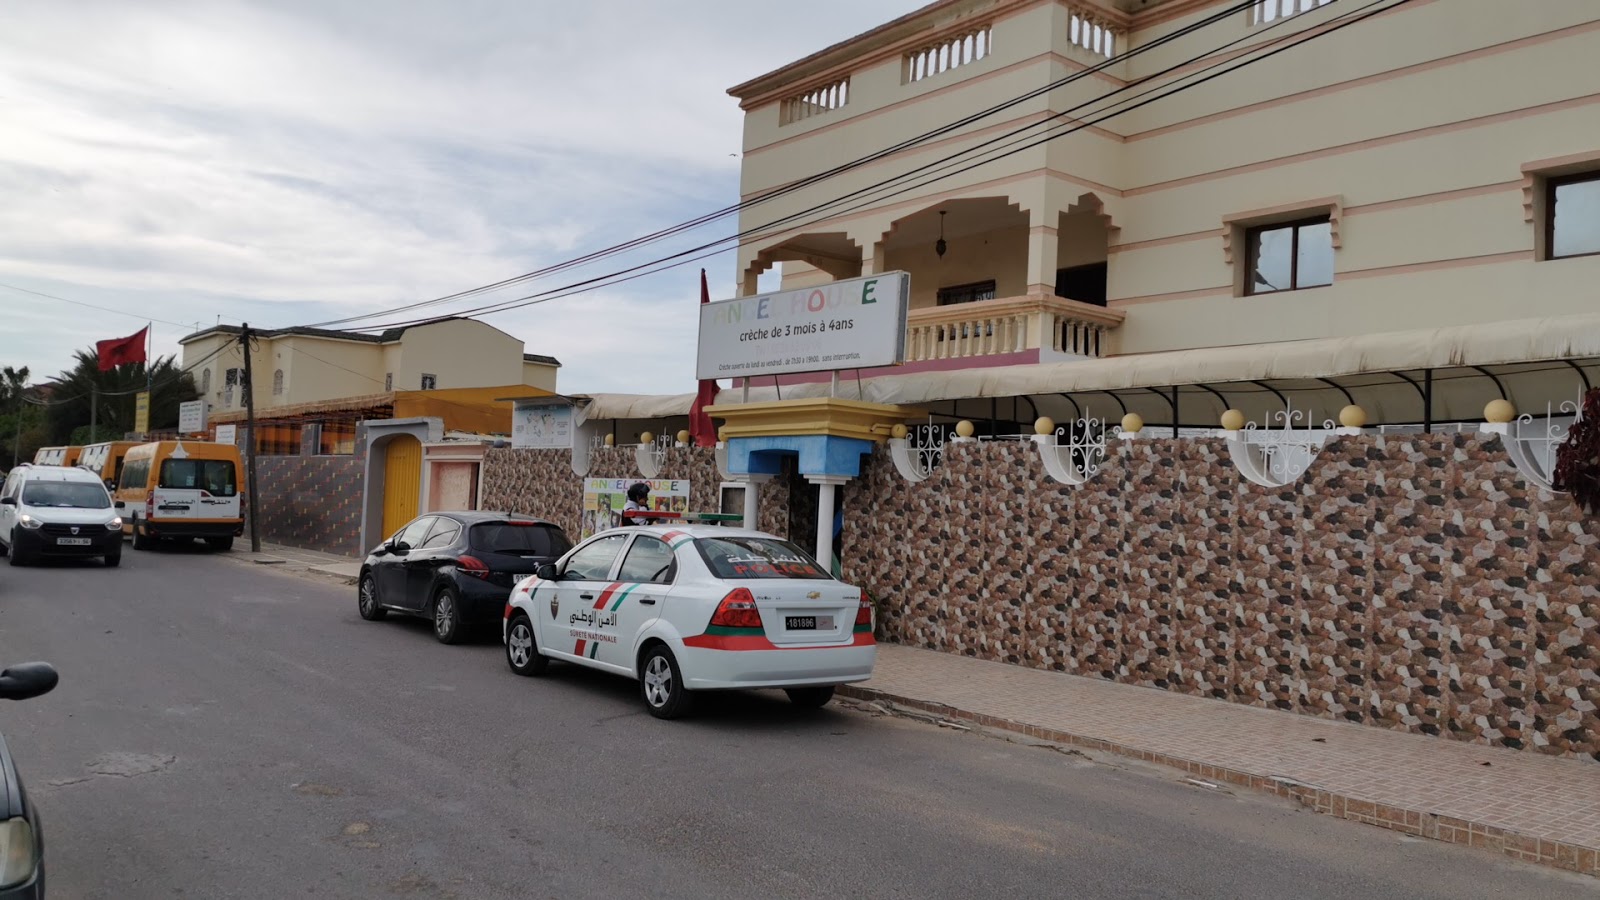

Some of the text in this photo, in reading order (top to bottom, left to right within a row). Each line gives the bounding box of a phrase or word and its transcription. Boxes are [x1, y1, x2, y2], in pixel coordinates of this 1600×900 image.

[739, 318, 854, 342] crèche de 3 mois à 4ans
[734, 564, 817, 575] POLICE
[569, 609, 597, 626] الوطني
[588, 633, 617, 643] NATIONALE
